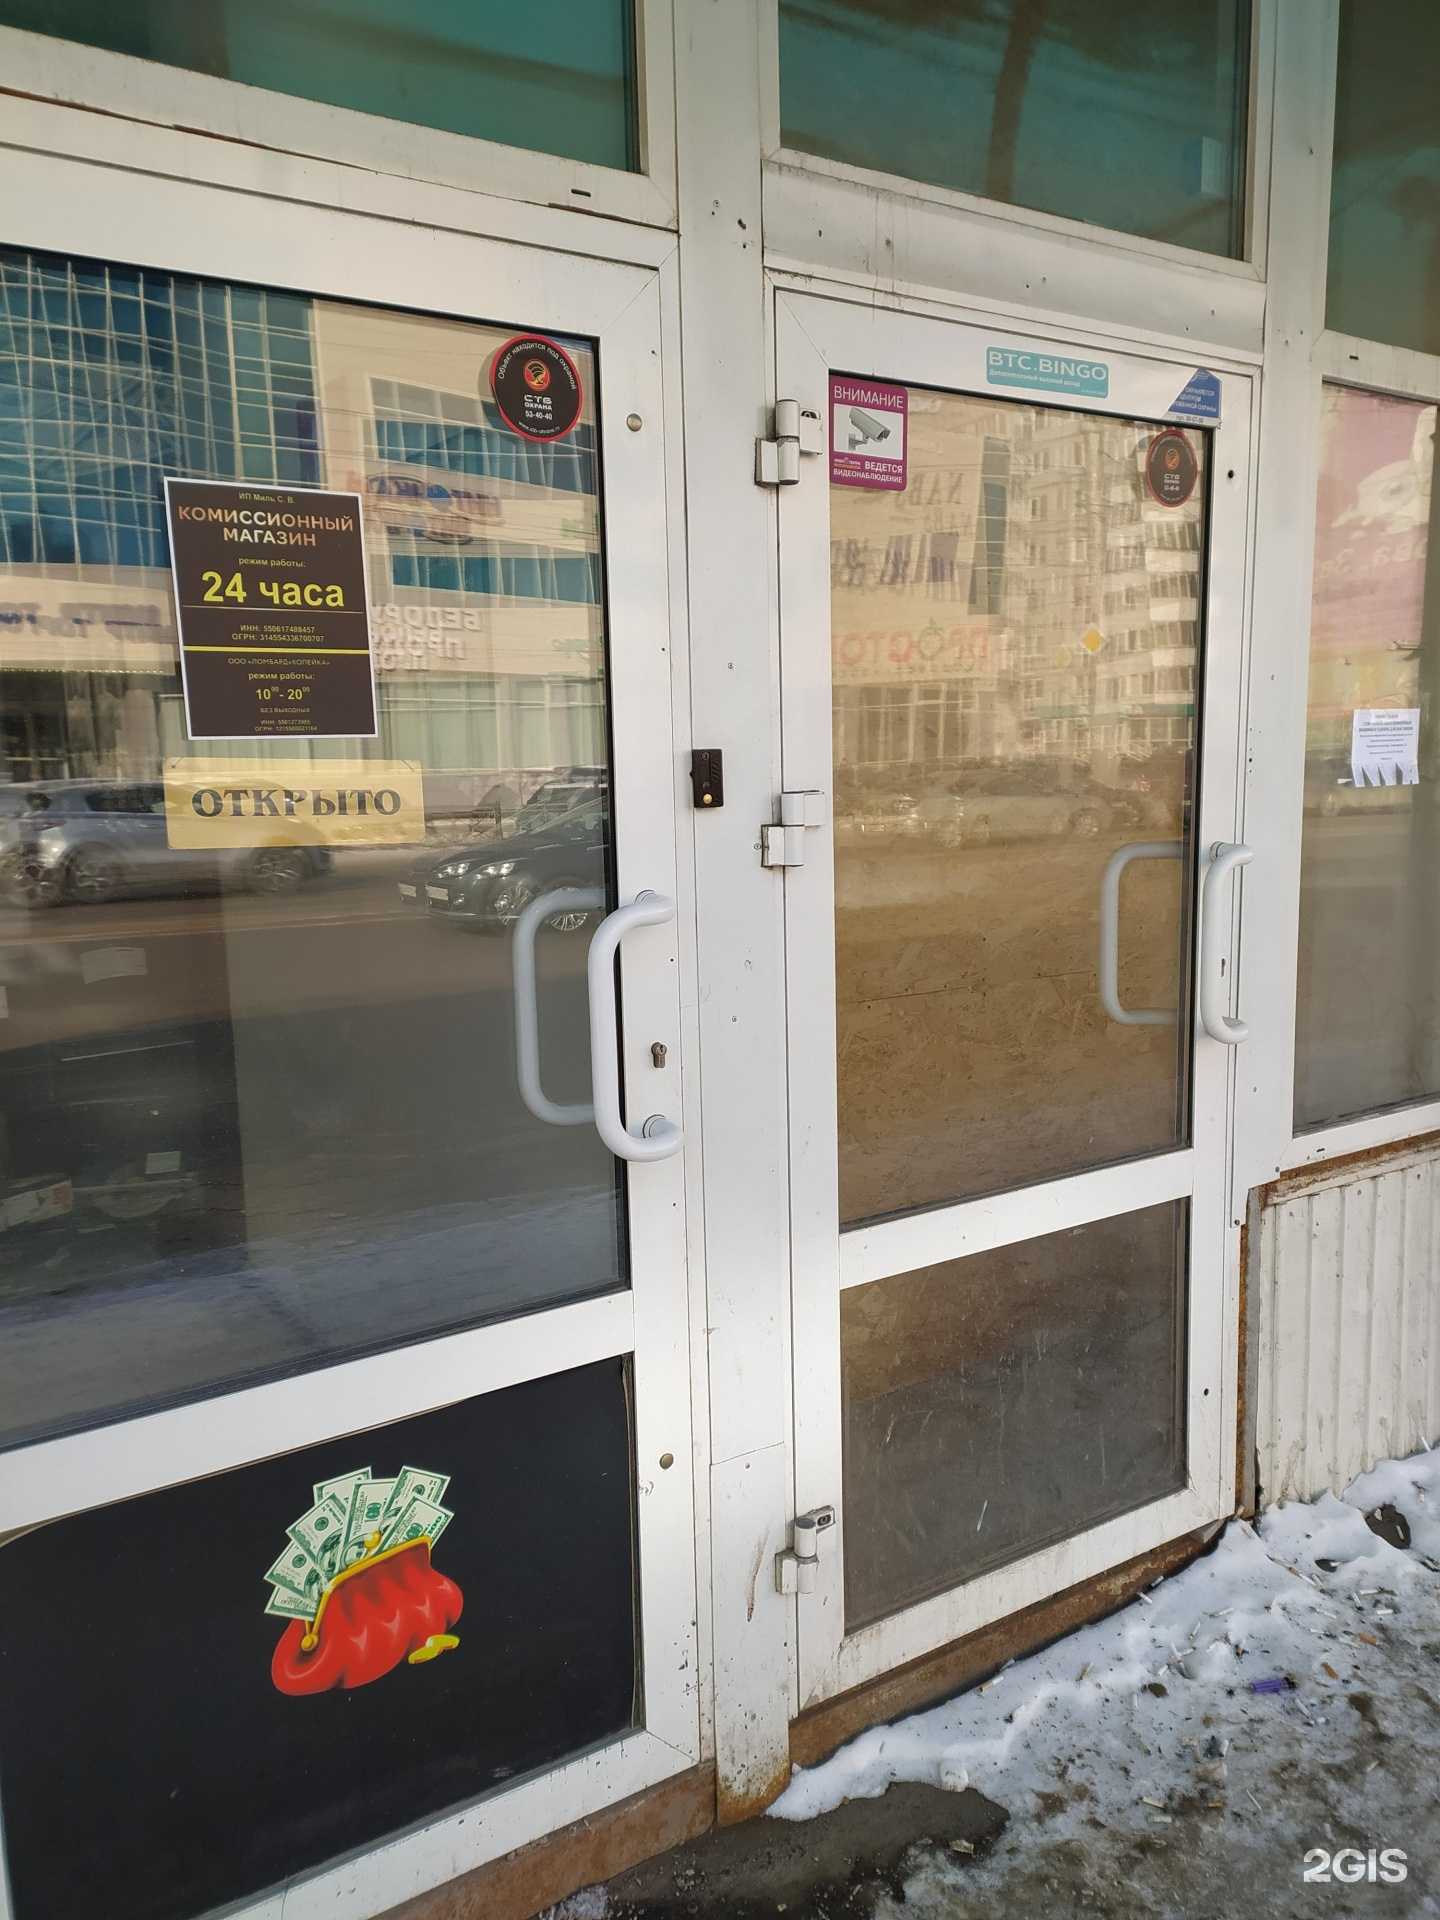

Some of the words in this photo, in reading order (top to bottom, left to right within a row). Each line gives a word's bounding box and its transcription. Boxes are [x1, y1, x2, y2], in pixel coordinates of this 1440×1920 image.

[498, 353, 512, 379] Объект
[512, 342, 546, 354] находится
[546, 347, 561, 360] под
[989, 351, 1107, 380] BTC.BINGO
[834, 385, 904, 409] ВНИМАНИЕ
[524, 402, 552, 410] ОХРАНА
[525, 410, 552, 420] 53-40-40
[865, 461, 903, 474] ВЕДЕТСЯ
[833, 468, 903, 483] ВИДЕОНАБЛЮДЕНИЕ
[239, 492, 251, 500] ИП
[178, 505, 354, 531] КОМИССИОННЫЙ
[223, 527, 317, 546] МАГАЗИН
[238, 557, 268, 567] режим
[270, 558, 306, 568] работы:
[202, 570, 247, 603] 24
[259, 581, 345, 607] часа
[240, 624, 260, 632] ИНН:
[231, 633, 258, 641] ОГРН:
[228, 657, 246, 665] ООО
[248, 672, 278, 681] режим
[279, 671, 315, 681] работы:
[192, 788, 401, 817] ОТКРЫТО
